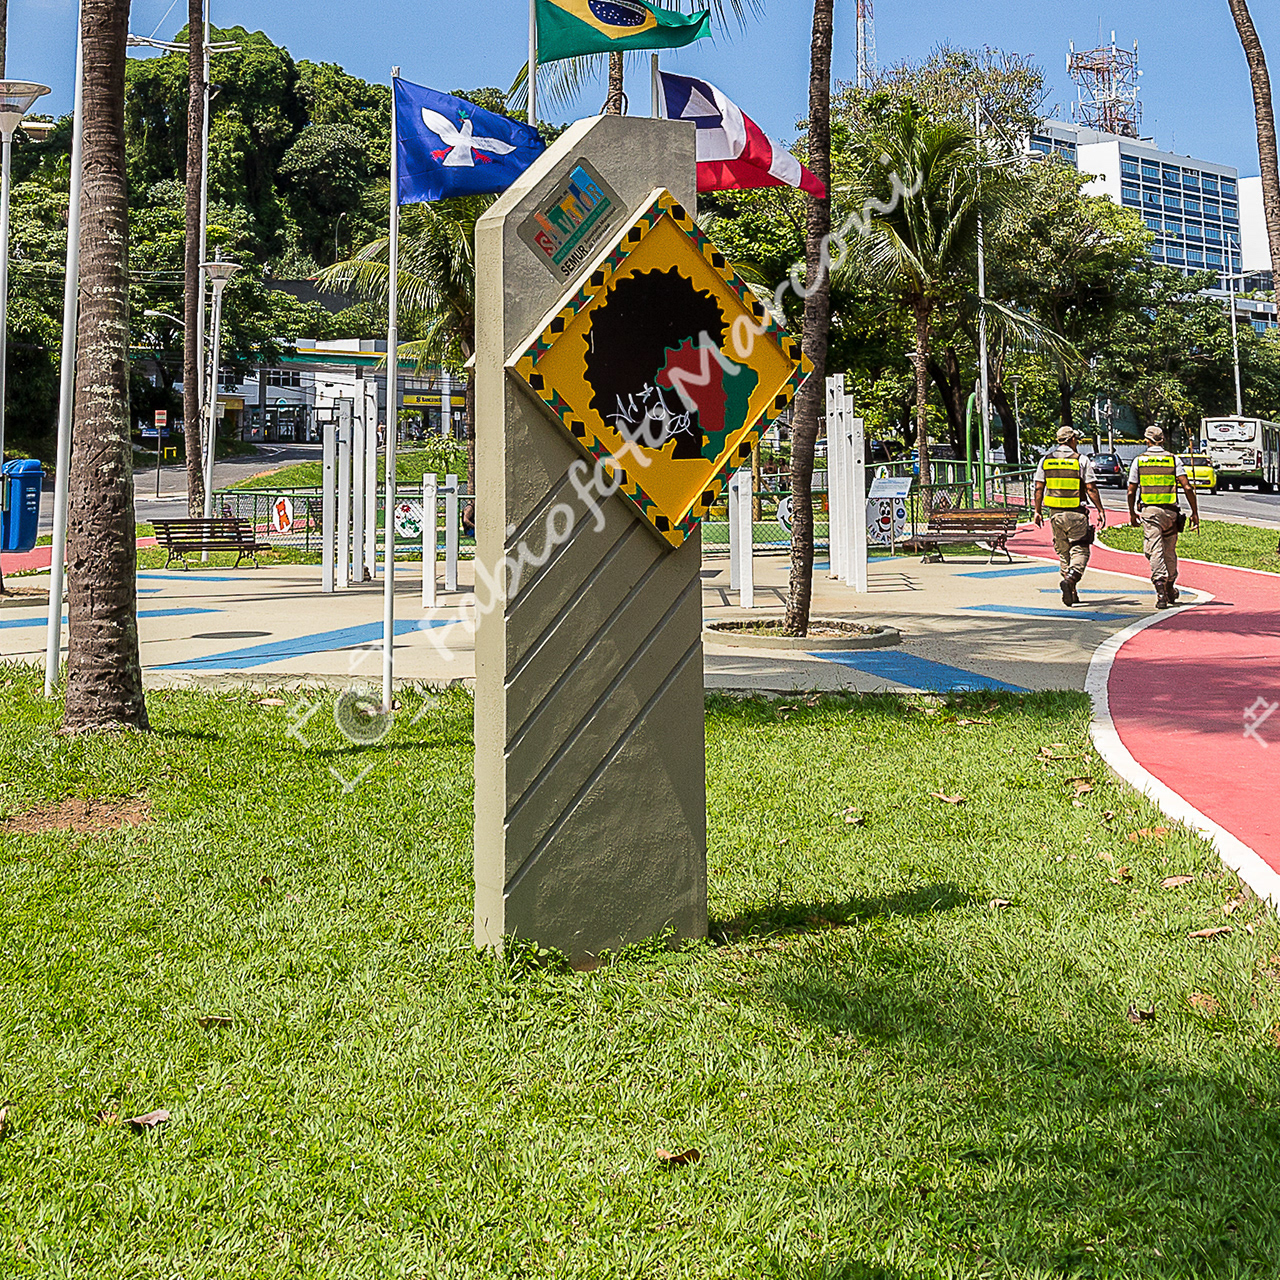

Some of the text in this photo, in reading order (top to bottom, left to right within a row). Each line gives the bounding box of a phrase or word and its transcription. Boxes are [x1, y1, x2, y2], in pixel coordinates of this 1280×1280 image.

[533, 165, 604, 257] SALVADOR
[560, 244, 589, 276] SEMUR
[867, 524, 904, 542] INFANIL
